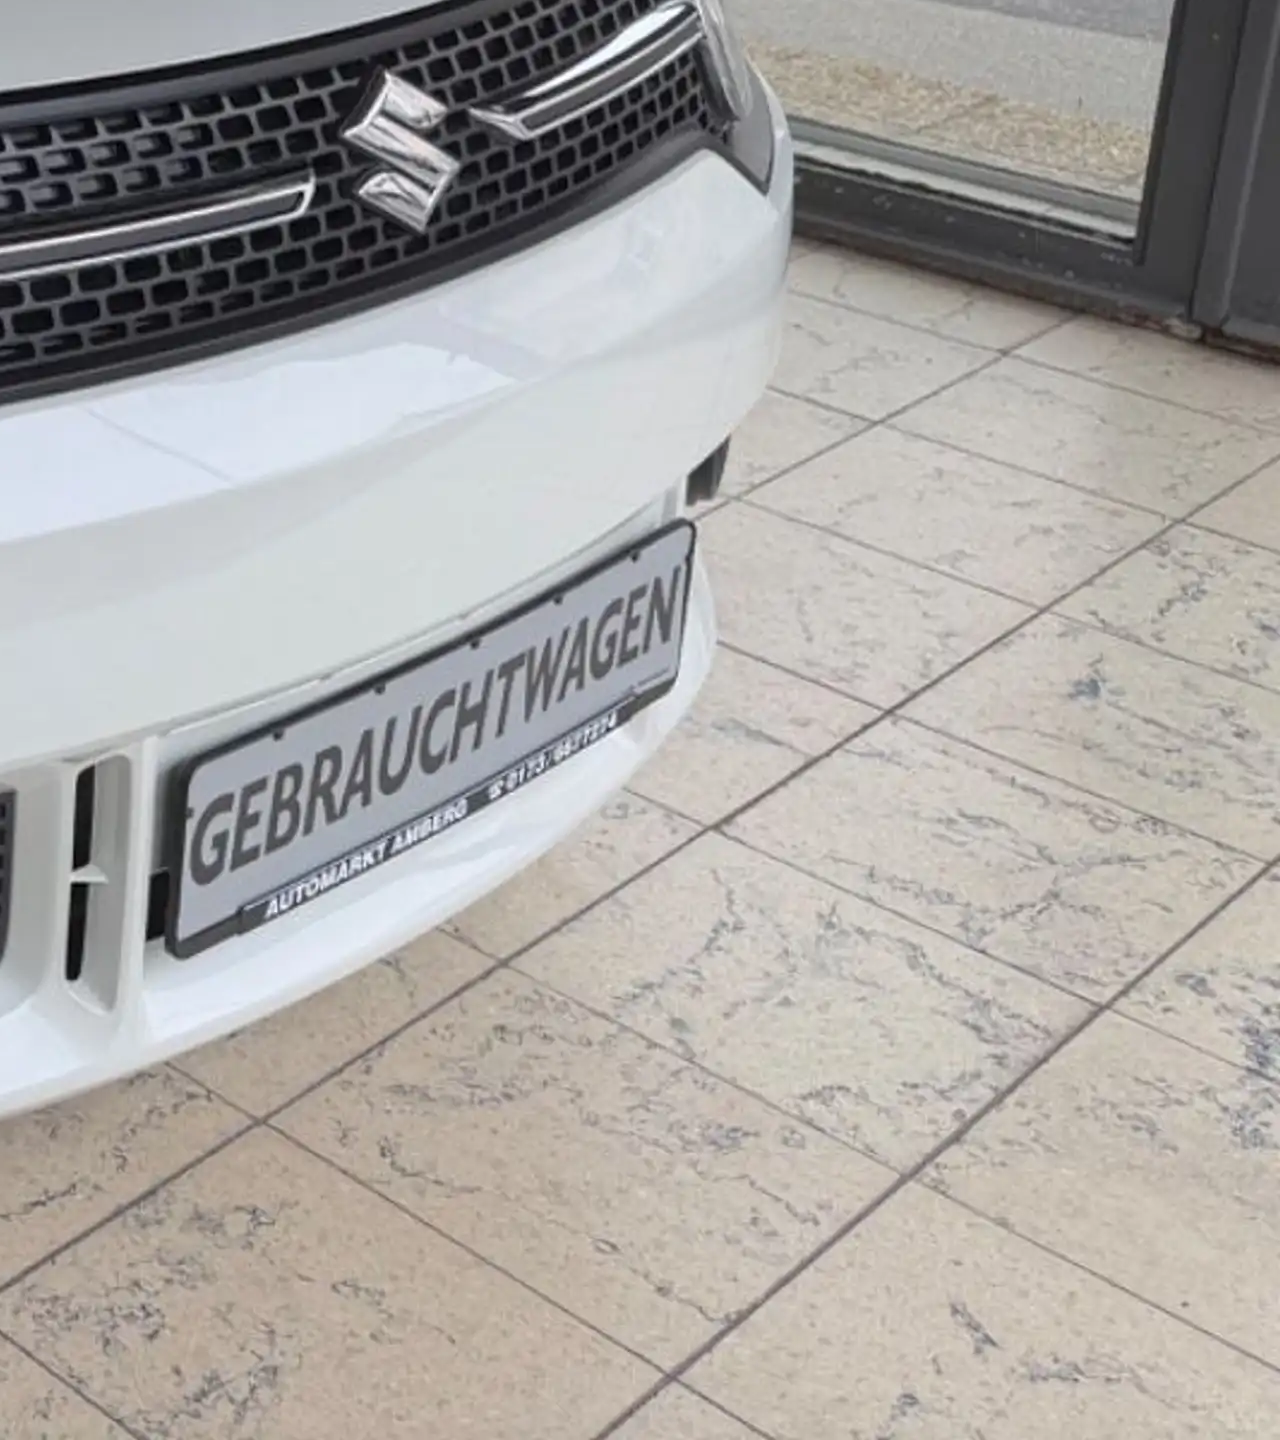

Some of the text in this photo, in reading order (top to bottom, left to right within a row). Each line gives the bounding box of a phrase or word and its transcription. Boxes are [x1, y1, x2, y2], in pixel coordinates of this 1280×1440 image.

[190, 564, 681, 886] GEBRAUCHTWAGEN
[265, 839, 388, 918] AUTOMARKT
[391, 798, 469, 853] AMBERG
